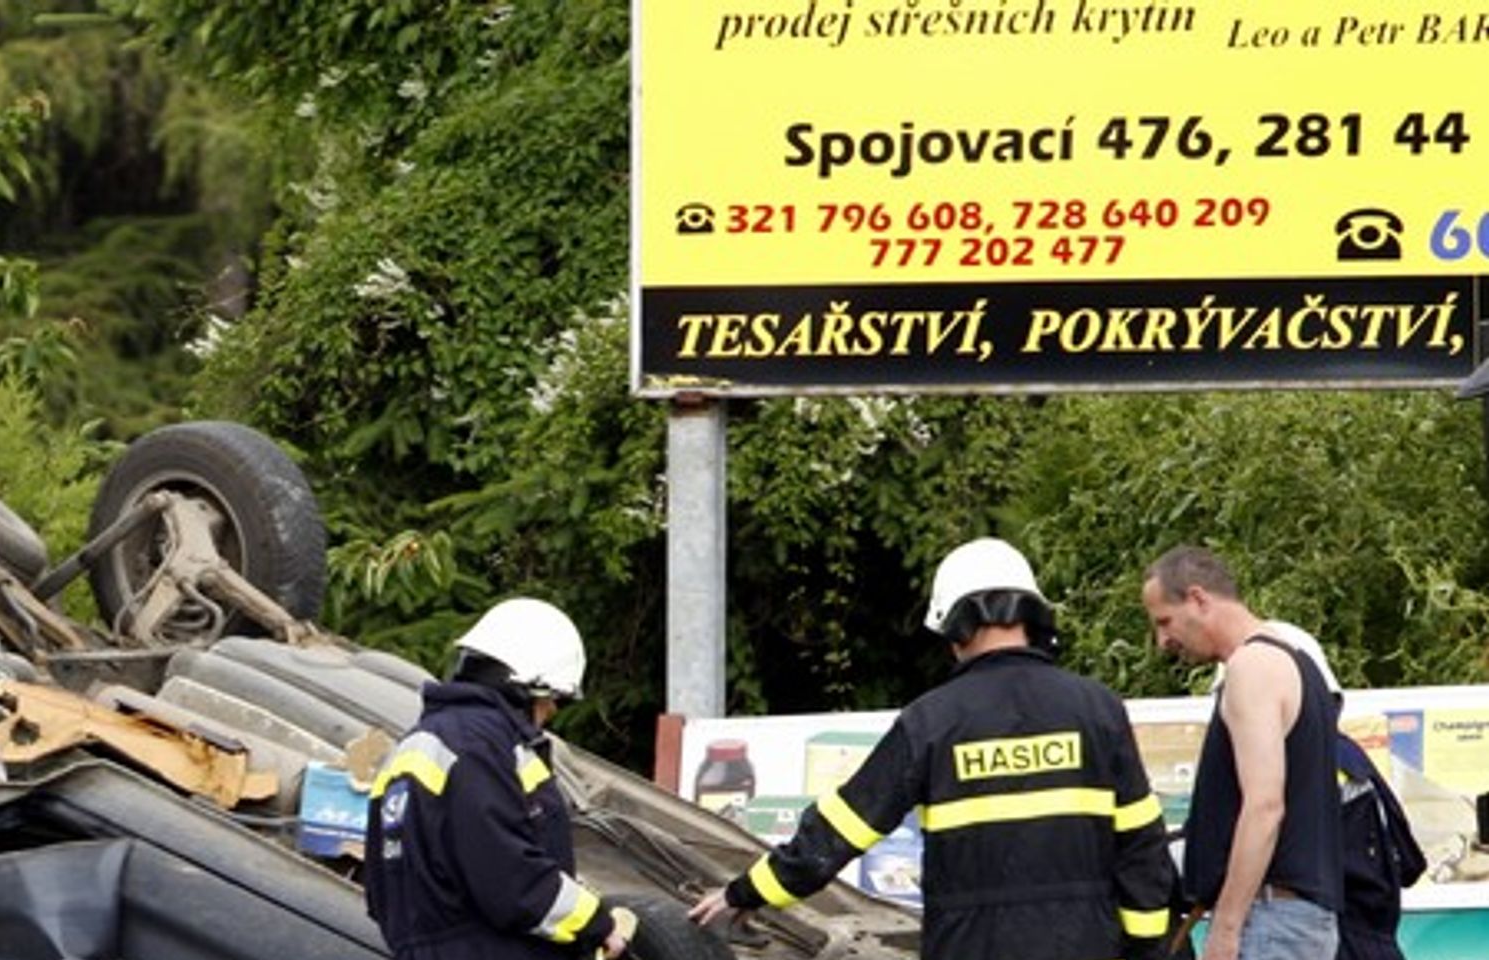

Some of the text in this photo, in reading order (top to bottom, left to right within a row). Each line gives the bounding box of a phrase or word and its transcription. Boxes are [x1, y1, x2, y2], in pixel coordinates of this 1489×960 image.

[716, 0, 852, 50] prodej
[1228, 20, 1288, 47] Leo
[1302, 28, 1320, 46] a
[1335, 17, 1404, 44] Petr
[785, 112, 1470, 179] Spojovací 476, 281 44
[727, 198, 1270, 234] 321 796 608, 728 640 209
[871, 236, 1125, 267] 777 202 477
[678, 292, 1463, 361] TESAŘSTVÍ, POKRÝVAČSTVÍ,
[962, 739, 1076, 775] HASICI
